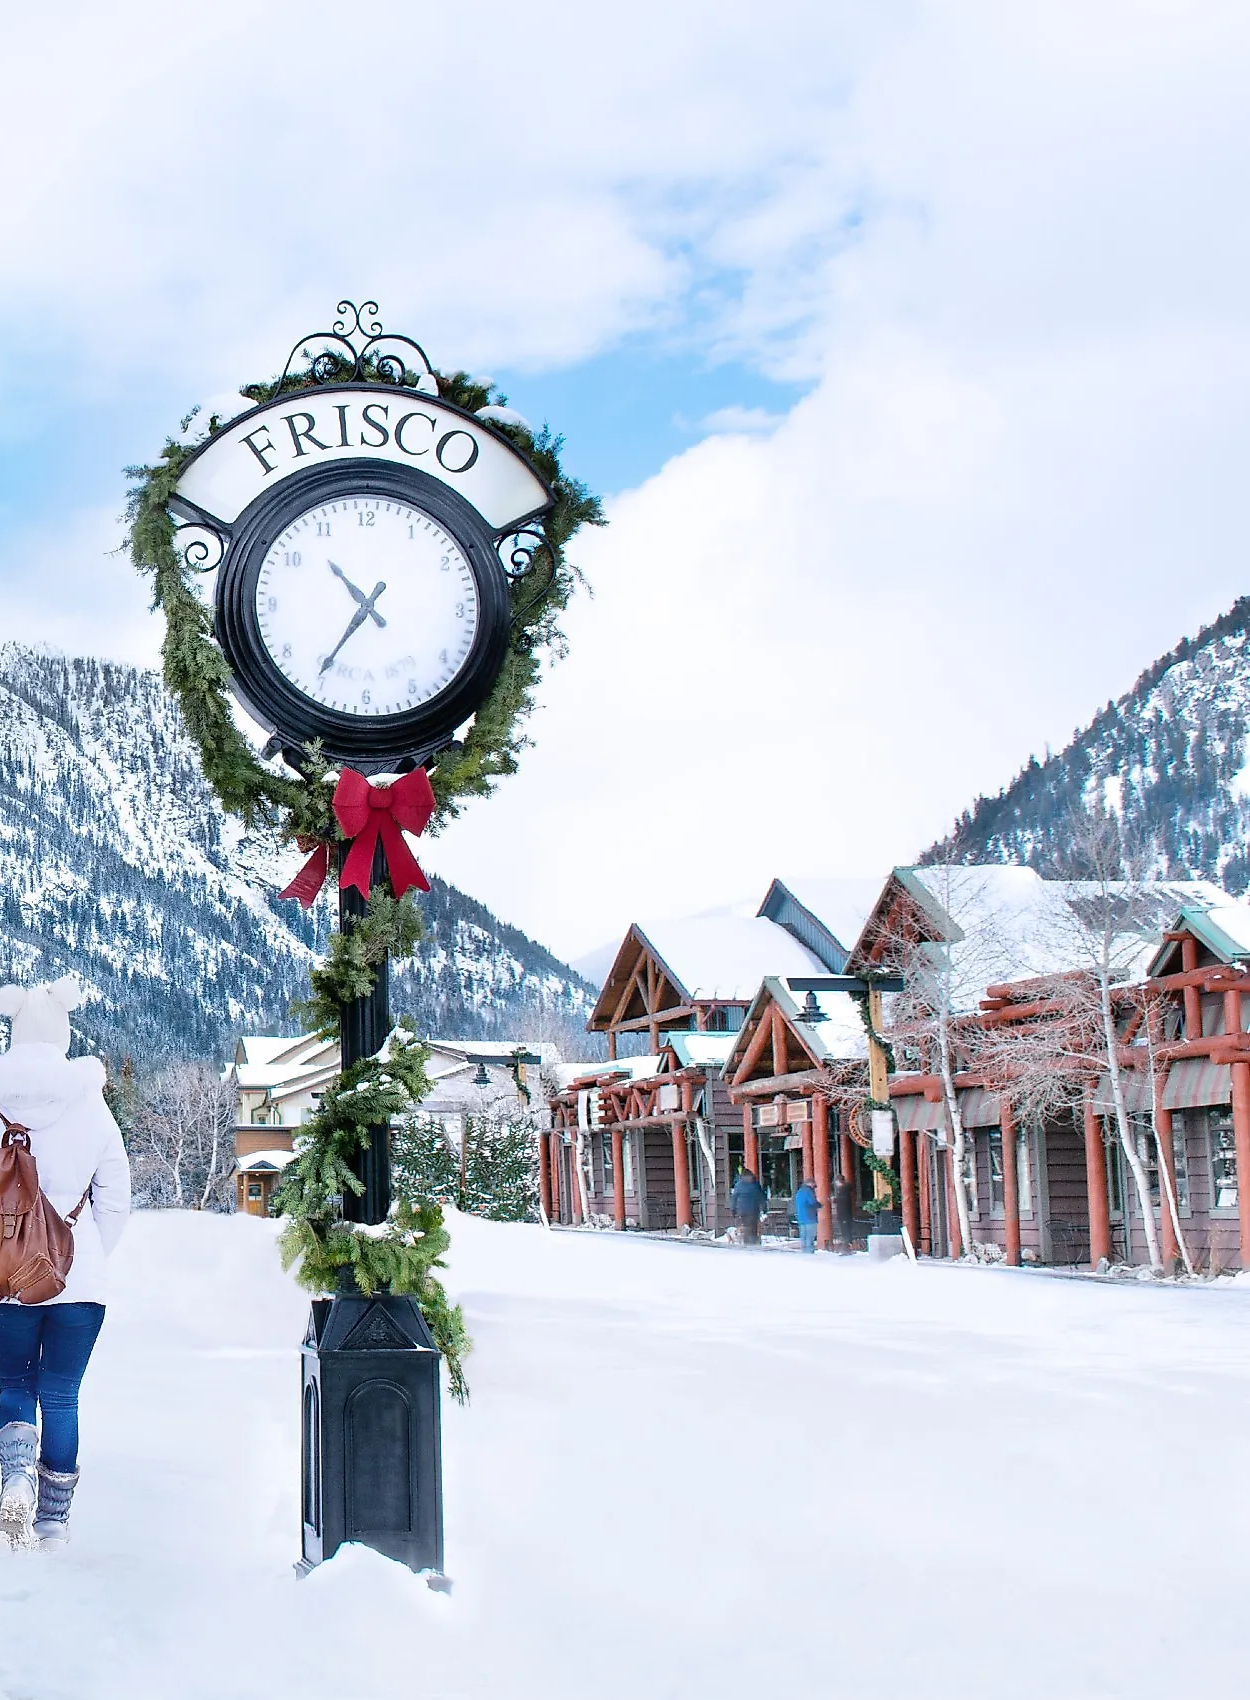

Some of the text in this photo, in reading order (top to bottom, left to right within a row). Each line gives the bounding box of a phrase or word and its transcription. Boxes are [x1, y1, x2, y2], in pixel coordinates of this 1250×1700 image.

[238, 404, 479, 476] FRISCO
[357, 511, 375, 527] 12
[316, 522, 331, 537] 11
[408, 525, 415, 539] 1
[283, 551, 301, 567] 10
[440, 556, 450, 571] 2
[268, 597, 277, 612] 9
[455, 603, 464, 618] 3
[282, 644, 292, 658] 8
[439, 649, 448, 664] 4
[317, 654, 376, 682] CRCA
[318, 676, 326, 691] 7
[408, 679, 417, 694] 5
[362, 689, 371, 704] 6
